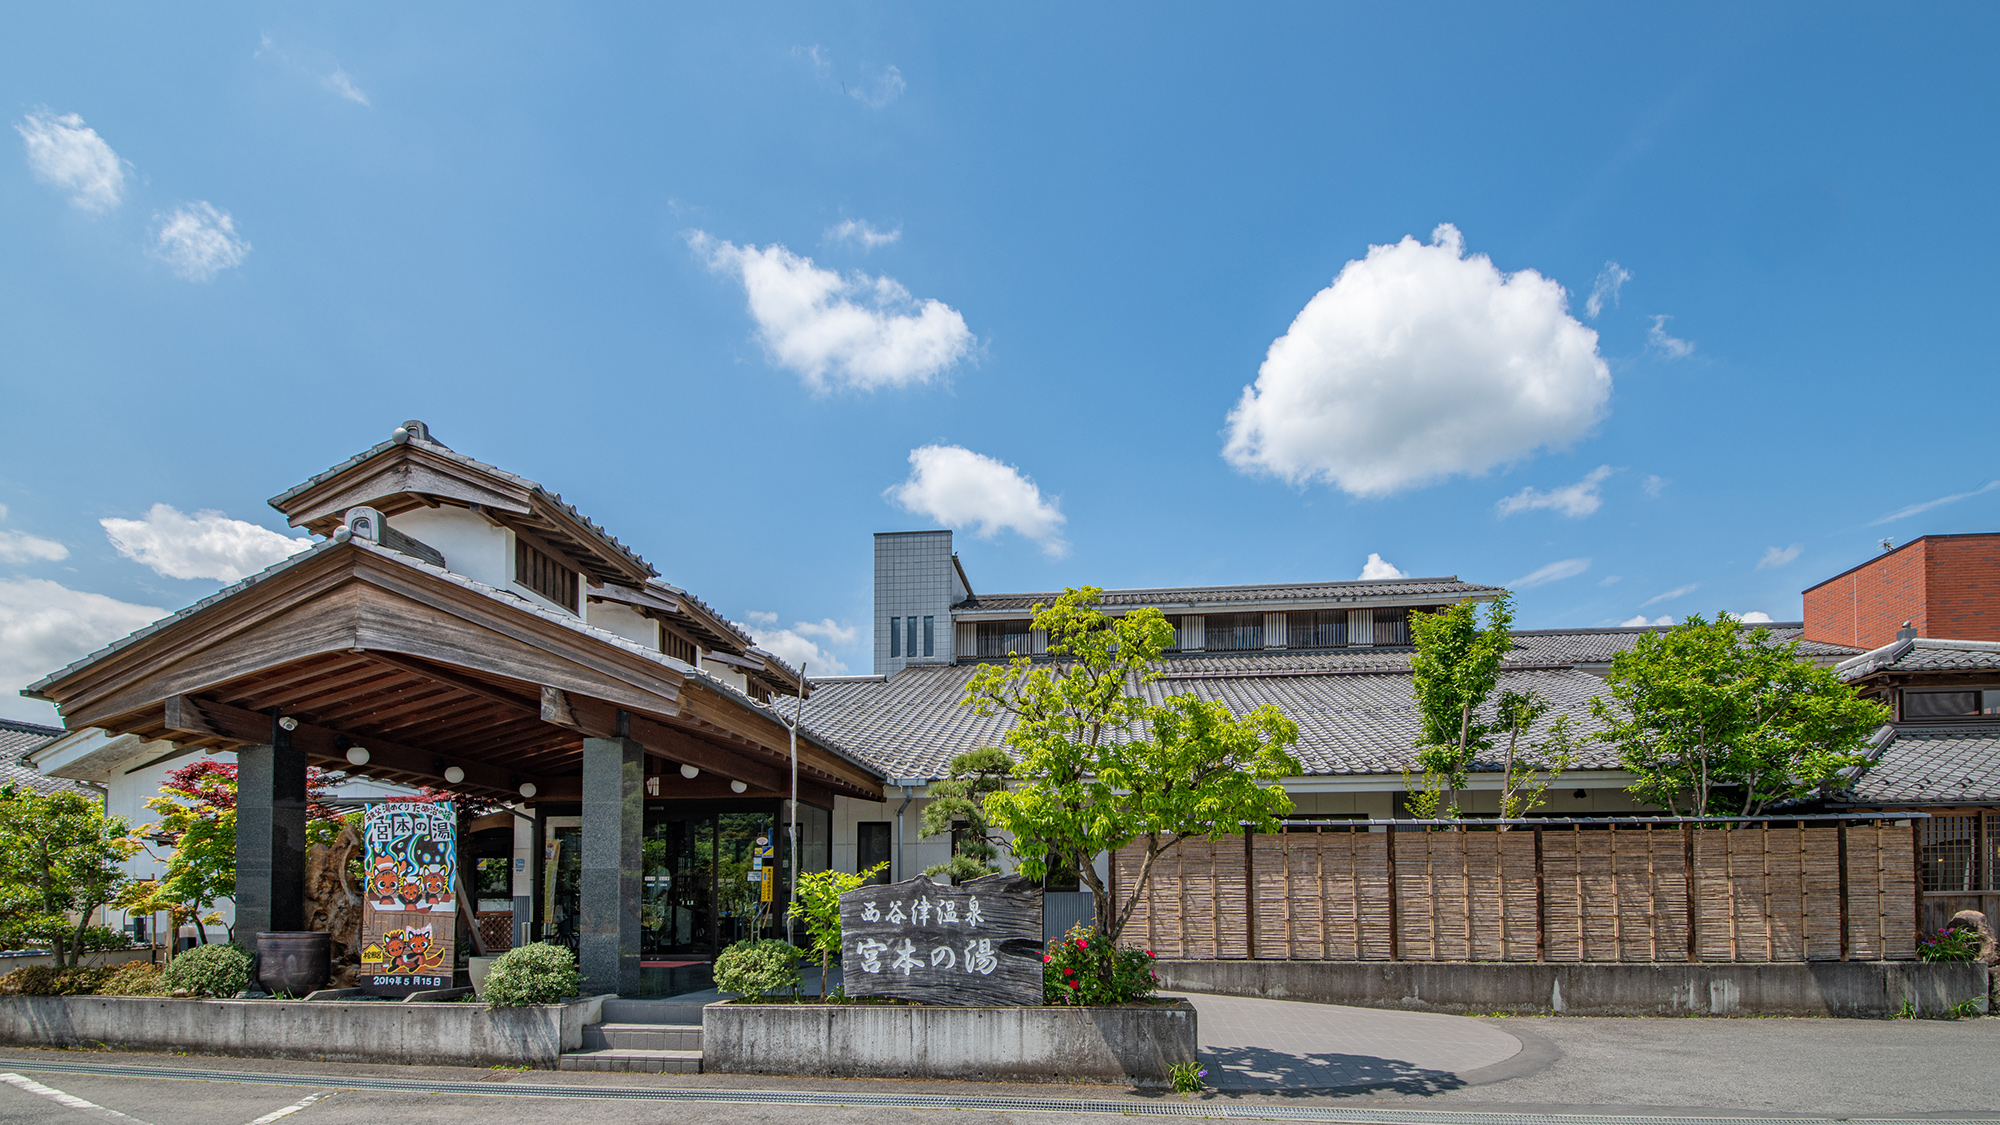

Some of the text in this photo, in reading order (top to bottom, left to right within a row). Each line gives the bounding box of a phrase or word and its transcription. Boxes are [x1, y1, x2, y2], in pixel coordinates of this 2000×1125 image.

[374, 818, 450, 841] 宮本の湯
[861, 895, 984, 927] 西谷津温泉
[857, 938, 998, 976] 宮本の湯
